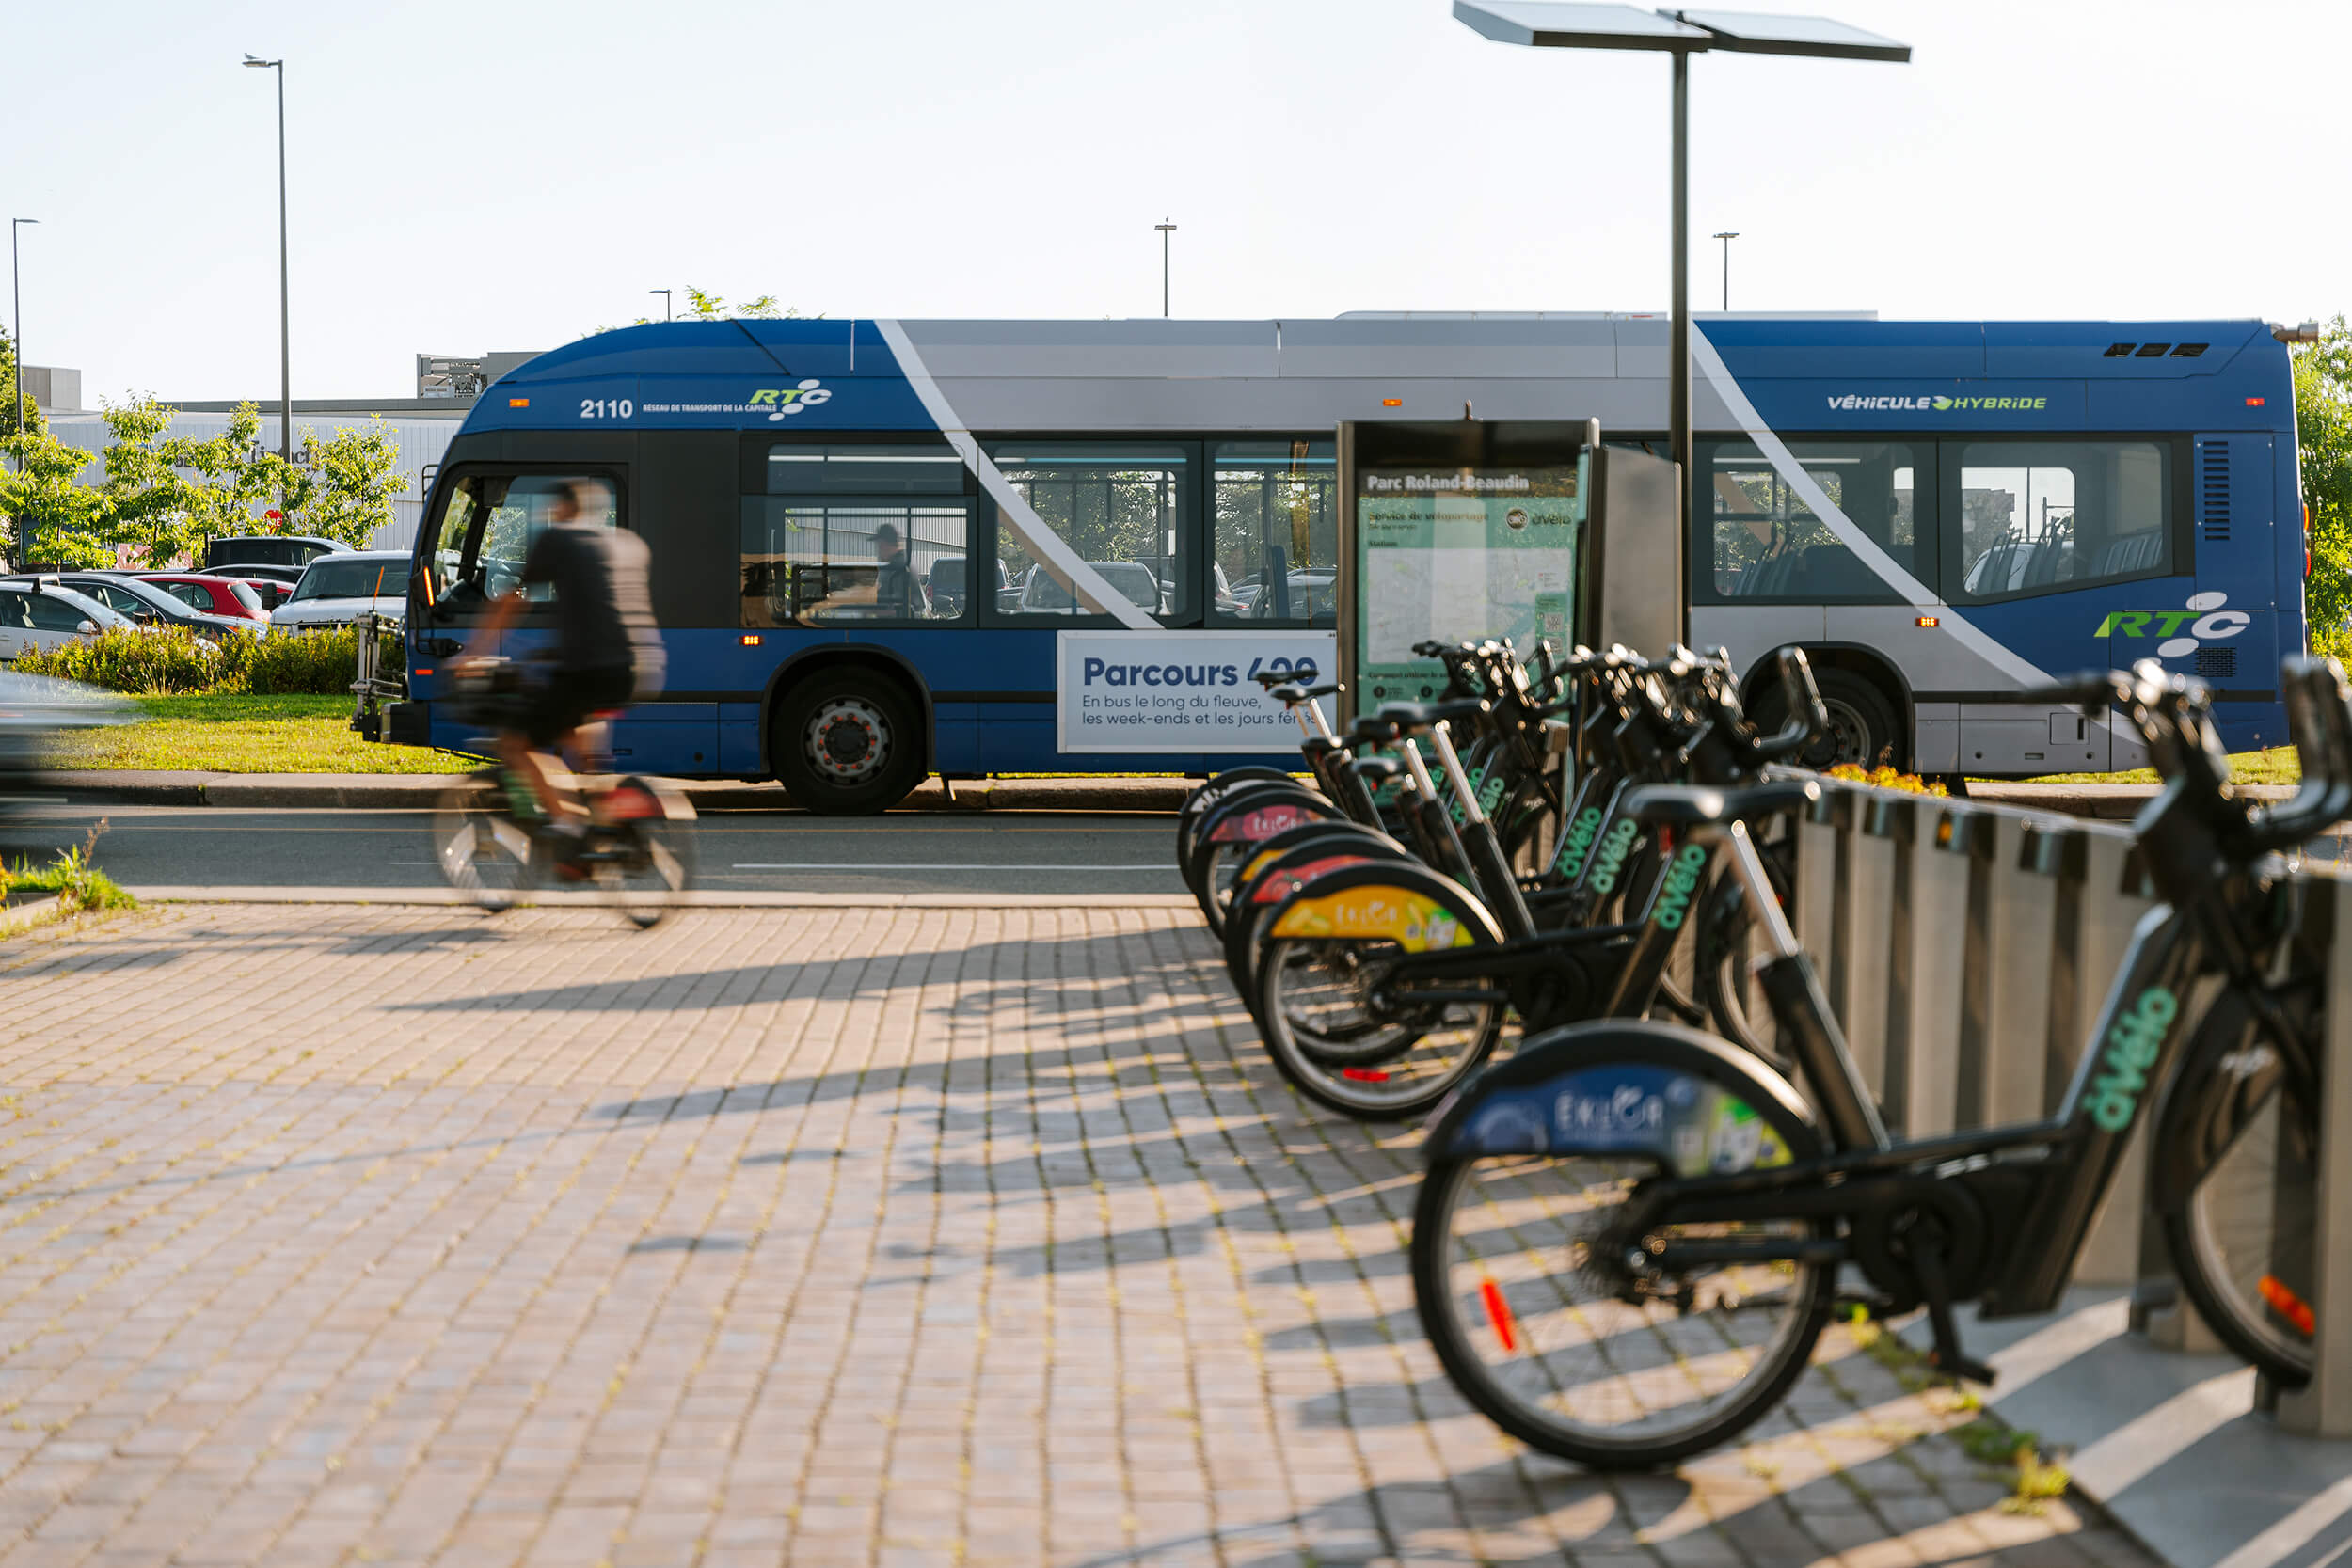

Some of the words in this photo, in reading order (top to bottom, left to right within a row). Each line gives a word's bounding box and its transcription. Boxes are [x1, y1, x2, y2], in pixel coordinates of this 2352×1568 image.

[749, 388, 832, 405] RTC
[580, 399, 633, 419] 2110
[643, 403, 669, 412] RÉSEAU
[670, 404, 680, 412] DE
[681, 404, 722, 412] TRANSPORT
[723, 404, 733, 412] DE
[734, 404, 743, 412] LA
[744, 404, 777, 412] CAPITALE
[1368, 475, 1401, 491] Parc
[2093, 611, 2251, 638] RTC
[1083, 657, 1239, 687] Parcours
[1083, 695, 1102, 708] En
[1104, 694, 1132, 708] bus
[1136, 694, 1149, 708] le
[1152, 694, 1185, 712] long
[1189, 694, 1209, 708] du
[1213, 694, 1262, 711] fleuve,
[1082, 711, 1103, 725] les
[1106, 711, 1191, 725] week-ends
[1194, 712, 1211, 725] et
[1215, 711, 1235, 725] les
[1237, 711, 1275, 728] jours
